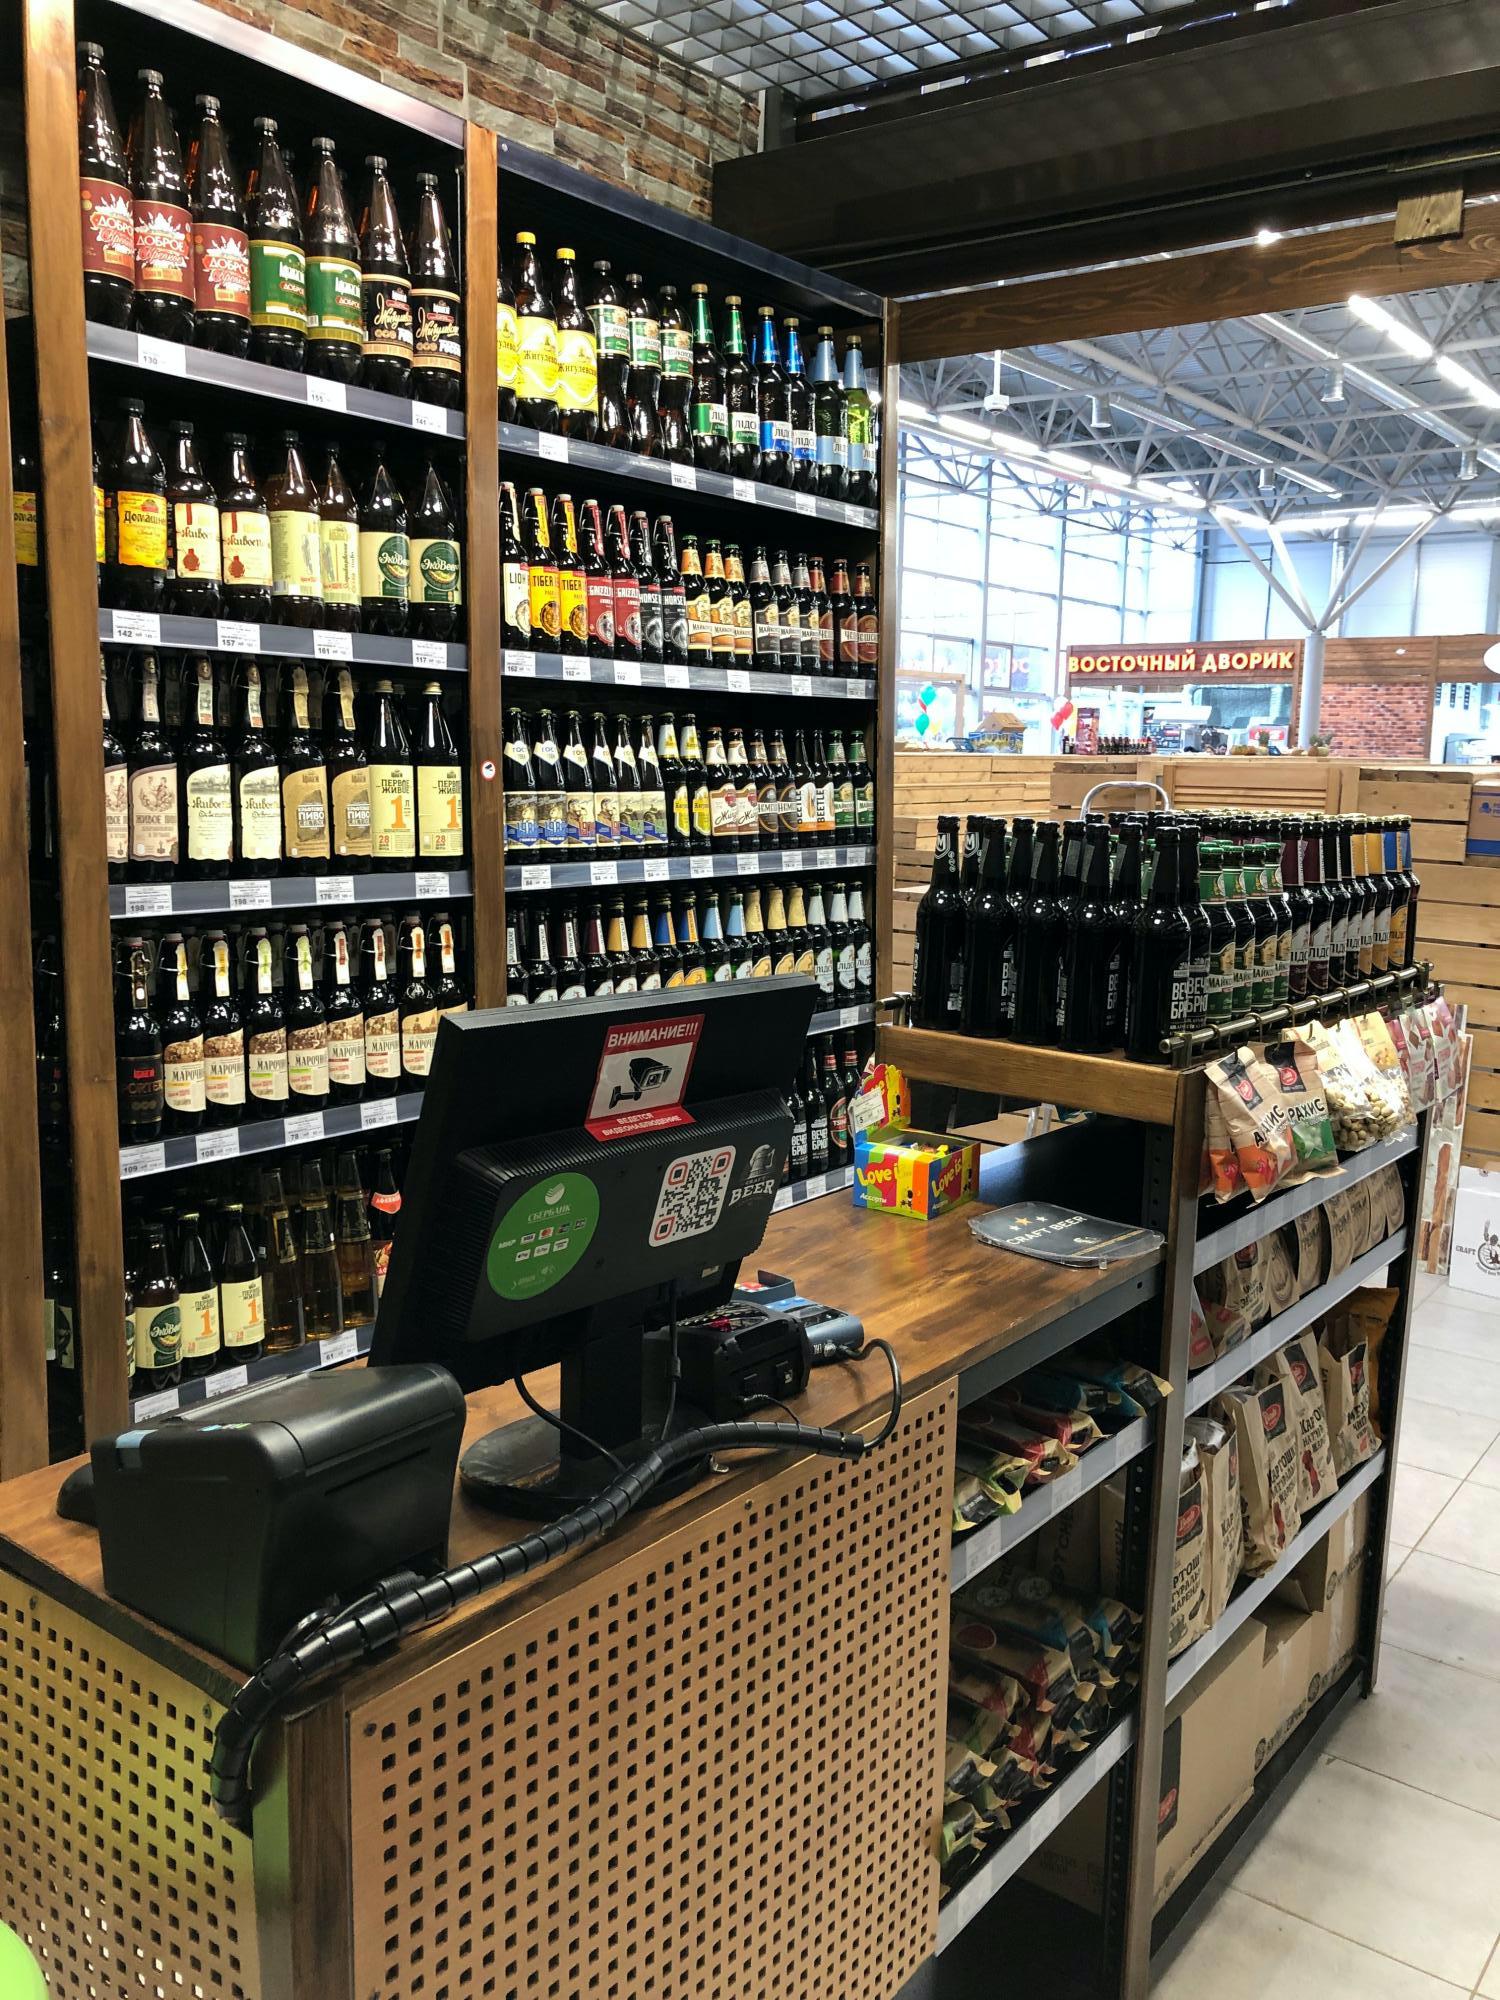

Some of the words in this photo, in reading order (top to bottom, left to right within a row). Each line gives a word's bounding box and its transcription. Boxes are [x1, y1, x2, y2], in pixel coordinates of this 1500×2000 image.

[532, 575, 554, 588] TIGER
[562, 579, 583, 591] TIGER
[117, 629, 133, 639] 142
[222, 638, 235, 648] 157
[416, 655, 428, 664] 117
[1068, 649, 1196, 674] ВОСТОЧНЫЙ
[1201, 651, 1295, 673] ДВОРИК
[390, 794, 407, 829] 1
[816, 789, 826, 823] BEETLE
[379, 834, 390, 843] 28
[436, 834, 446, 843] 28
[607, 1022, 699, 1048] ВНИМАНИЕ!!!
[616, 1112, 654, 1126] ВЕДЕТСЯ
[1288, 1098, 1326, 1122] РАХИС
[602, 1115, 682, 1136] ВИДЕОНАБЛЮДЕНИЕ
[124, 1164, 138, 1175] 109
[856, 1167, 892, 1186] Love
[728, 1179, 774, 1207] BEER
[931, 1169, 955, 1198] Love
[1006, 1225, 1053, 1246] CRAFT
[1048, 1214, 1089, 1233] BEER
